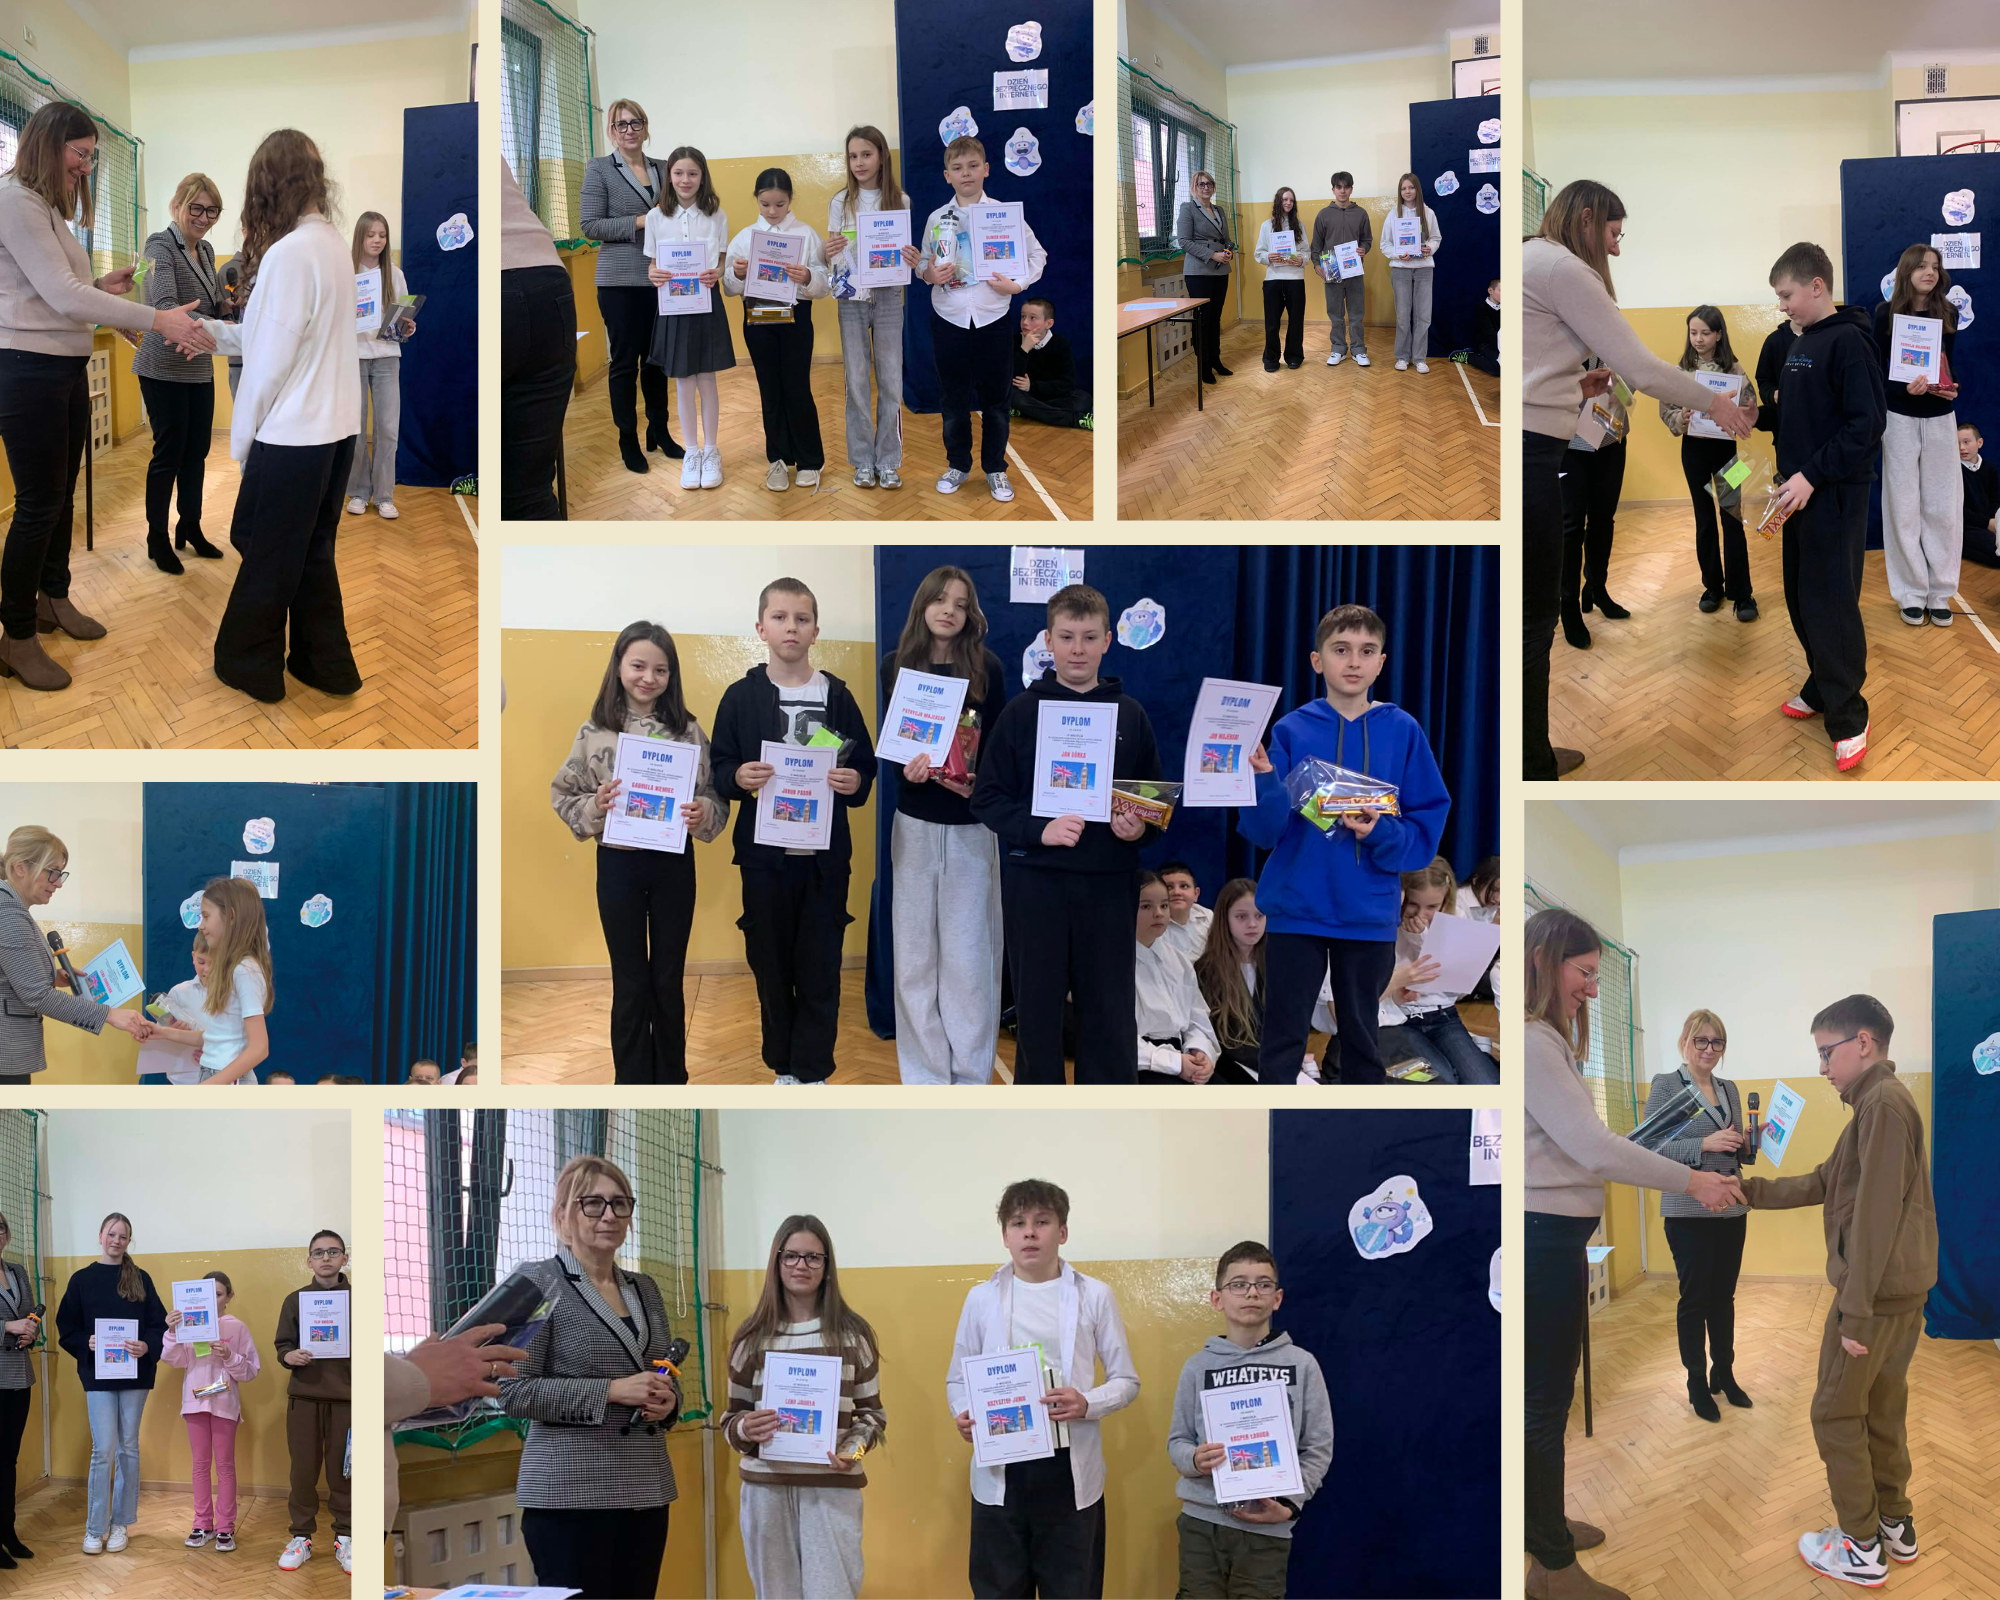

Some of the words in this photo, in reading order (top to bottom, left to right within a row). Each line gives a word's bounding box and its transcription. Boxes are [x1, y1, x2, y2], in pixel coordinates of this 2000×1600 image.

[1007, 76, 1029, 85] DZIEŃ
[873, 220, 894, 228] DYPLOM
[767, 240, 788, 249] DYPLOM
[1944, 238, 1963, 246] DZIEŃ
[1908, 323, 1927, 331] DYPLOM
[1709, 379, 1727, 387] DYPLOM
[1030, 557, 1058, 569] DZIEŃ
[1012, 567, 1083, 579] BEZPIECZNGO
[917, 683, 945, 695] DYPLOM
[1221, 696, 1251, 708] DYPLOM
[1061, 715, 1091, 727] DYPLOM
[642, 750, 673, 763] DYPLOM
[784, 757, 814, 768] DYPLOM
[788, 1366, 817, 1377] DYPLOM
[987, 1363, 1017, 1376] DYPLOM
[1211, 1365, 1291, 1387] WHATEVS
[1230, 1397, 1262, 1411] DYPLOM
